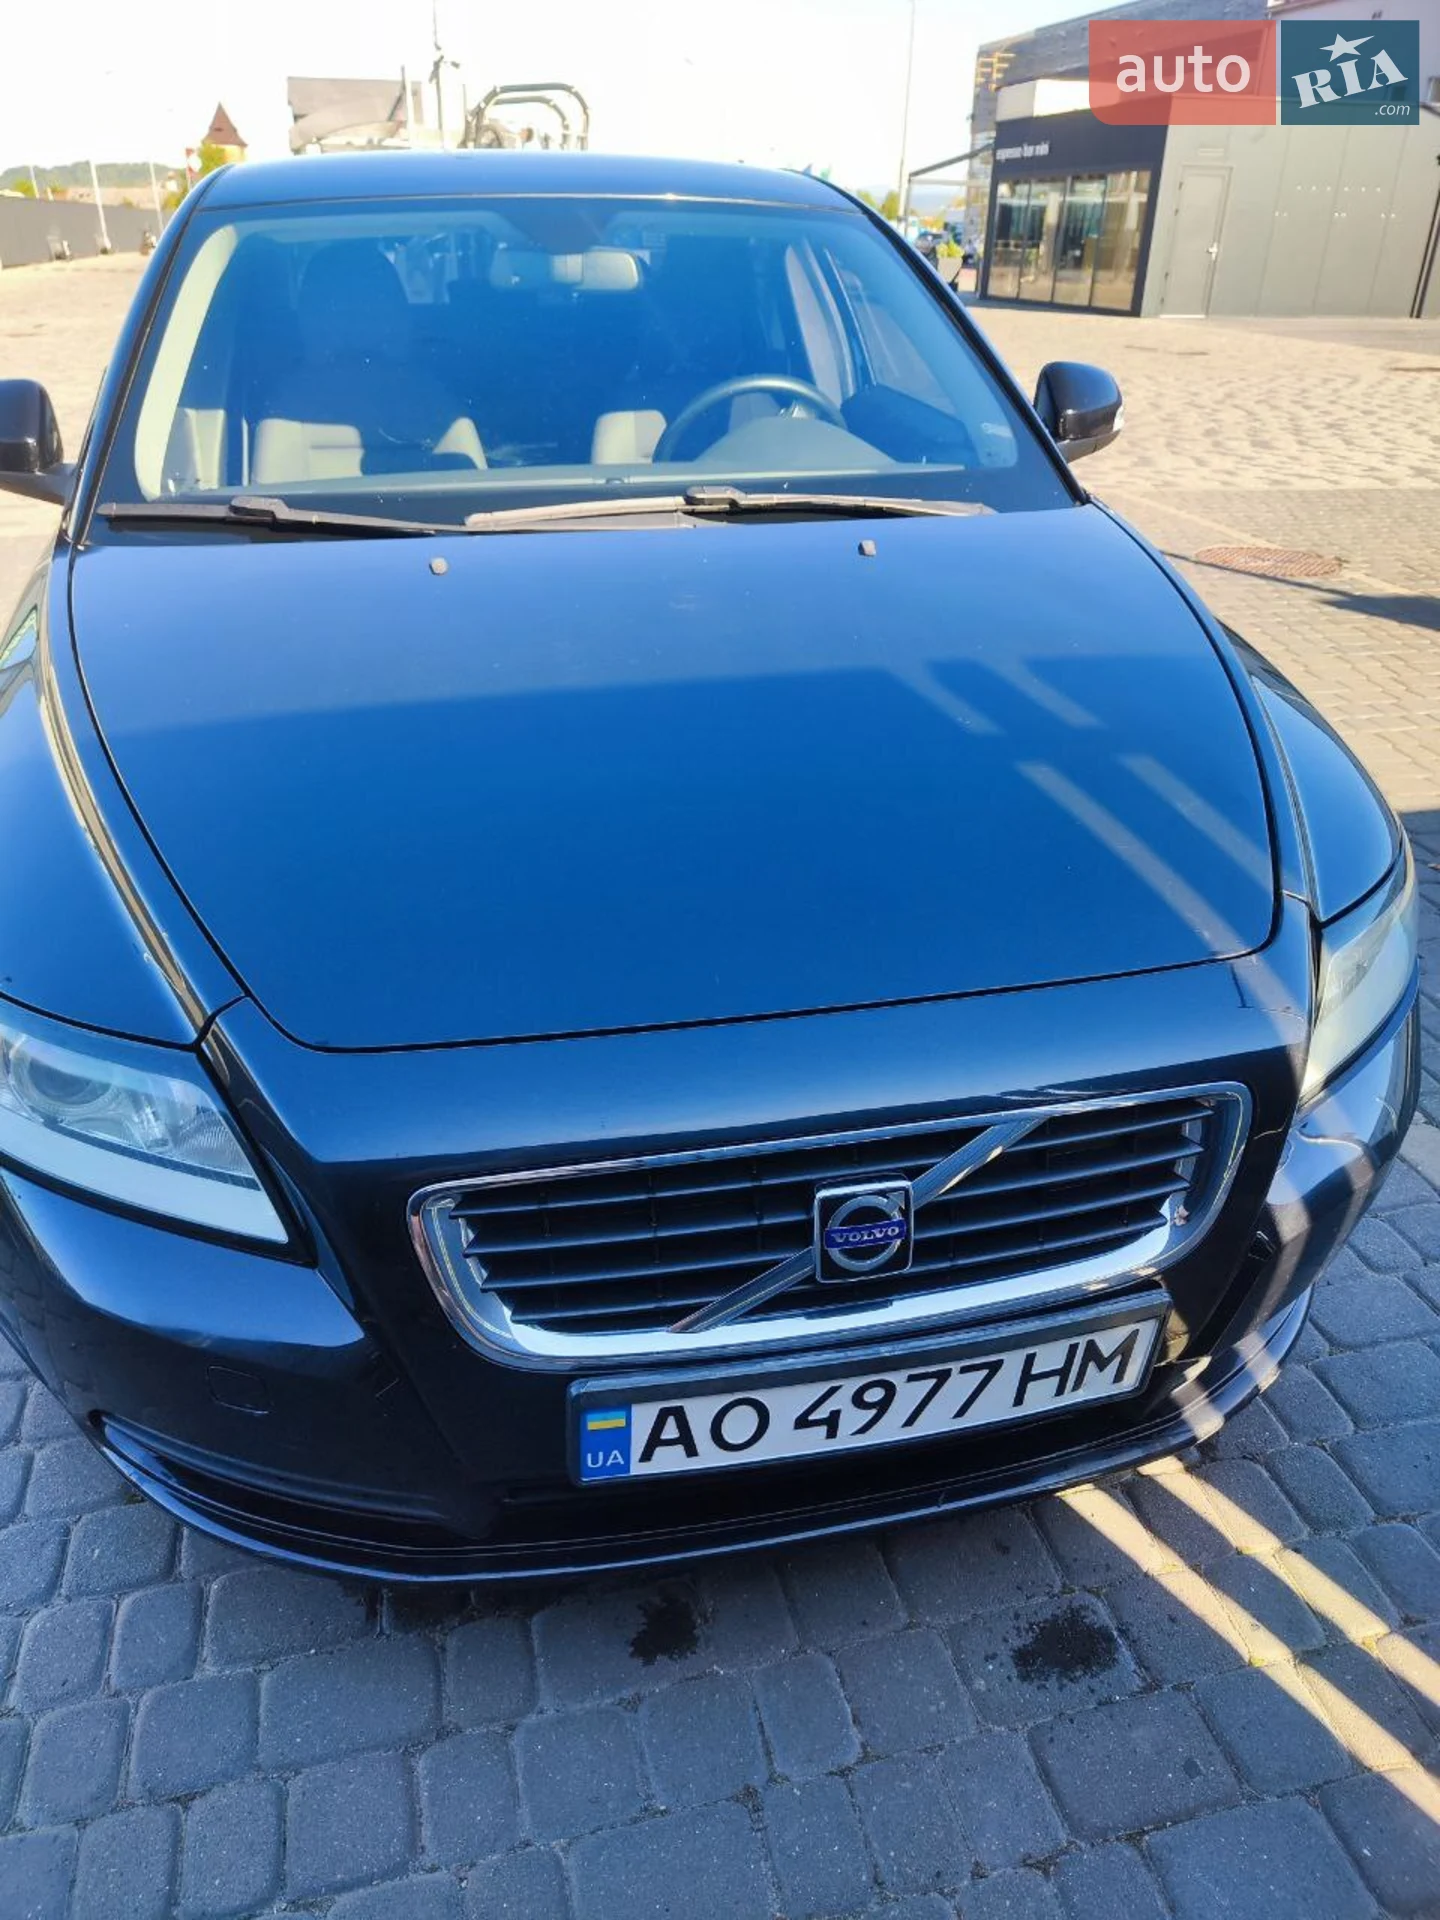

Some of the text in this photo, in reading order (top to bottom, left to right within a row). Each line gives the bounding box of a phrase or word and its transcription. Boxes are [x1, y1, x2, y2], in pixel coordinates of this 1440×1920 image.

[832, 1226, 900, 1243] VOLVO
[638, 1328, 1138, 1463] AO 4977 HM
[586, 1449, 625, 1468] UA
